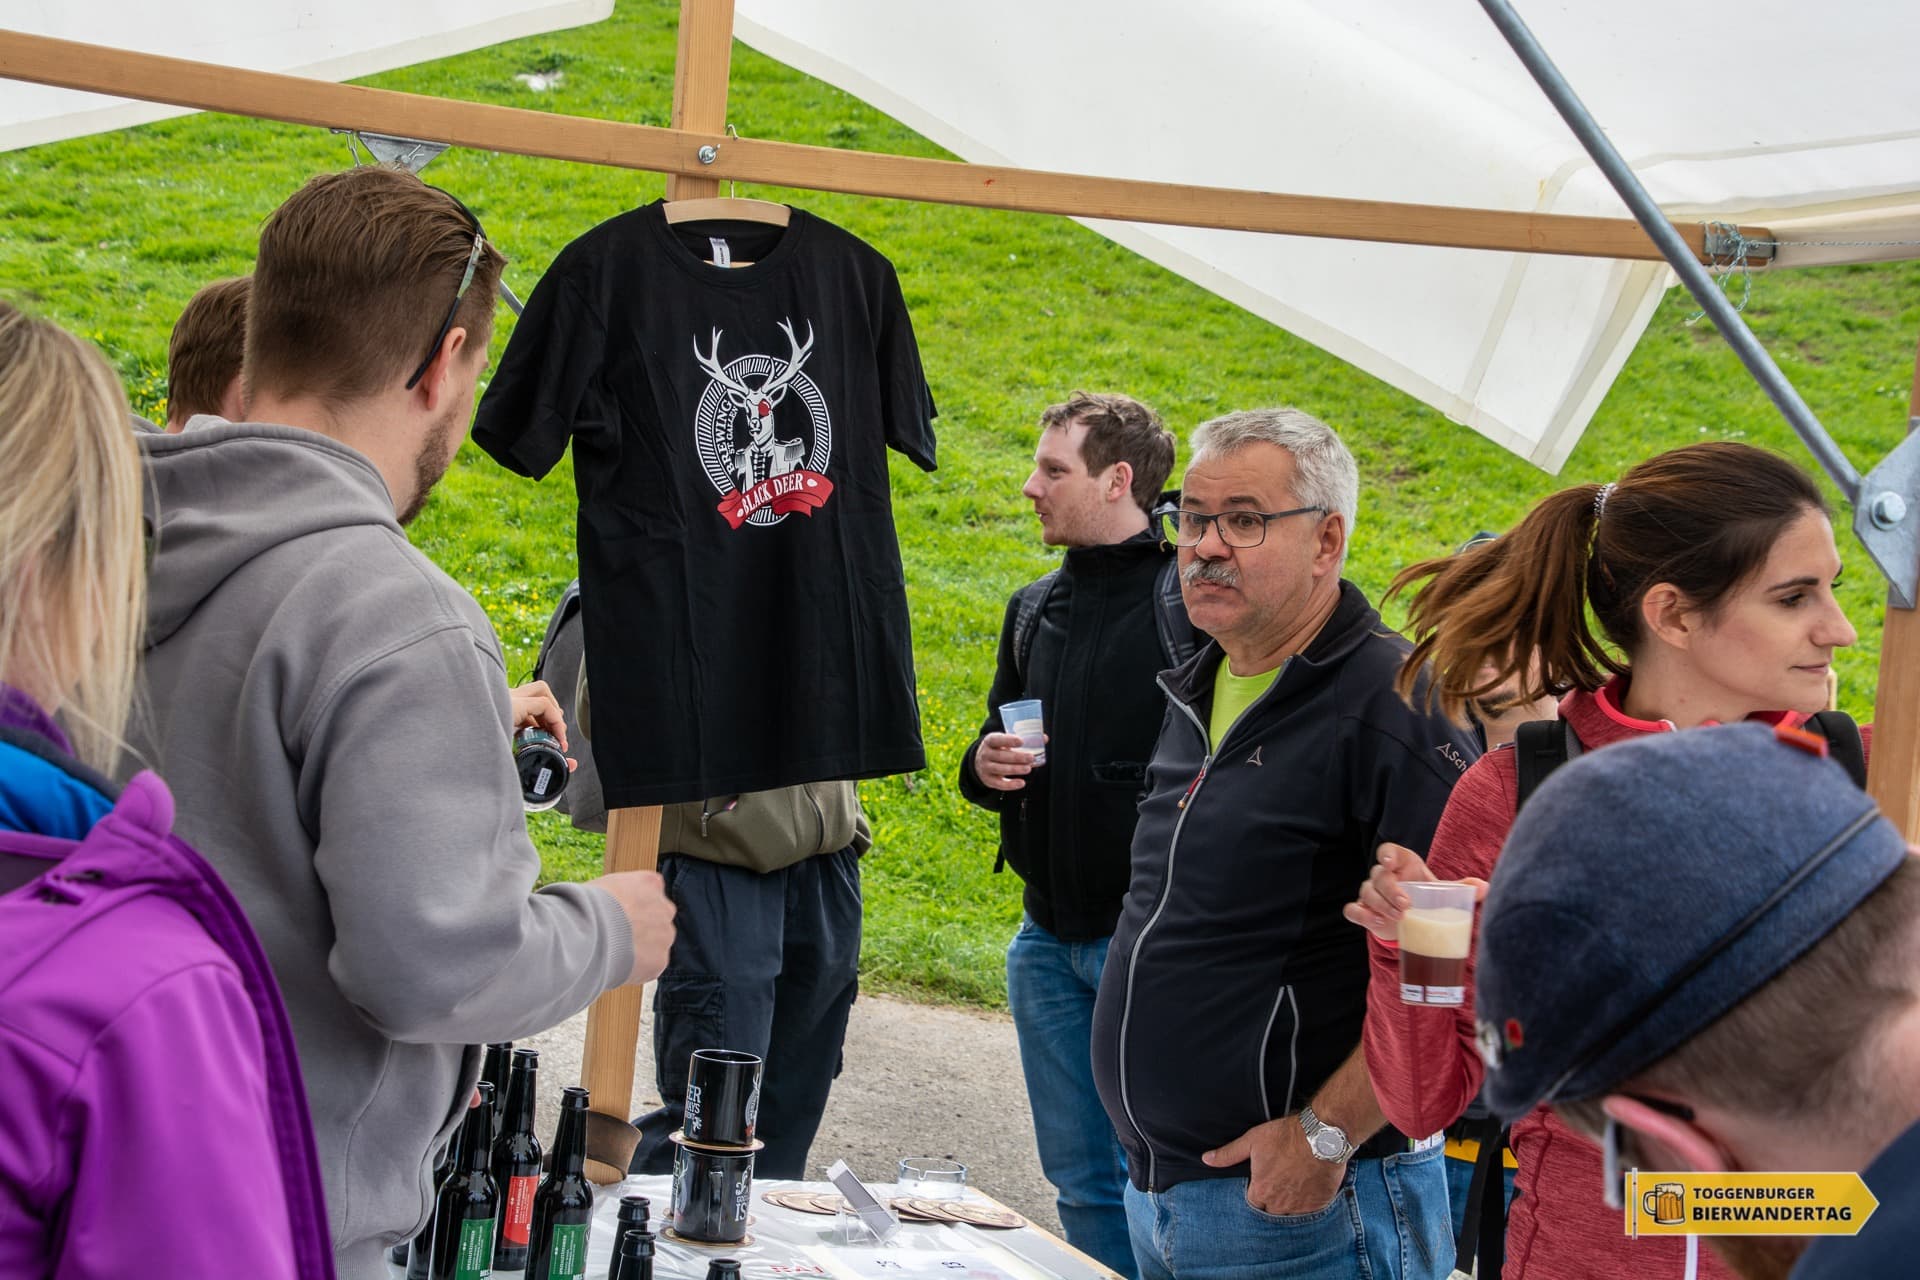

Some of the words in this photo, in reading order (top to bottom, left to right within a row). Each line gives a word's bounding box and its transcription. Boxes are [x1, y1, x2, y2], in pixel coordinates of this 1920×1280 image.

[715, 400, 735, 475] BREWING
[726, 406, 739, 440] GALLEN
[741, 482, 773, 514] BLACK
[773, 473, 804, 497] DEER
